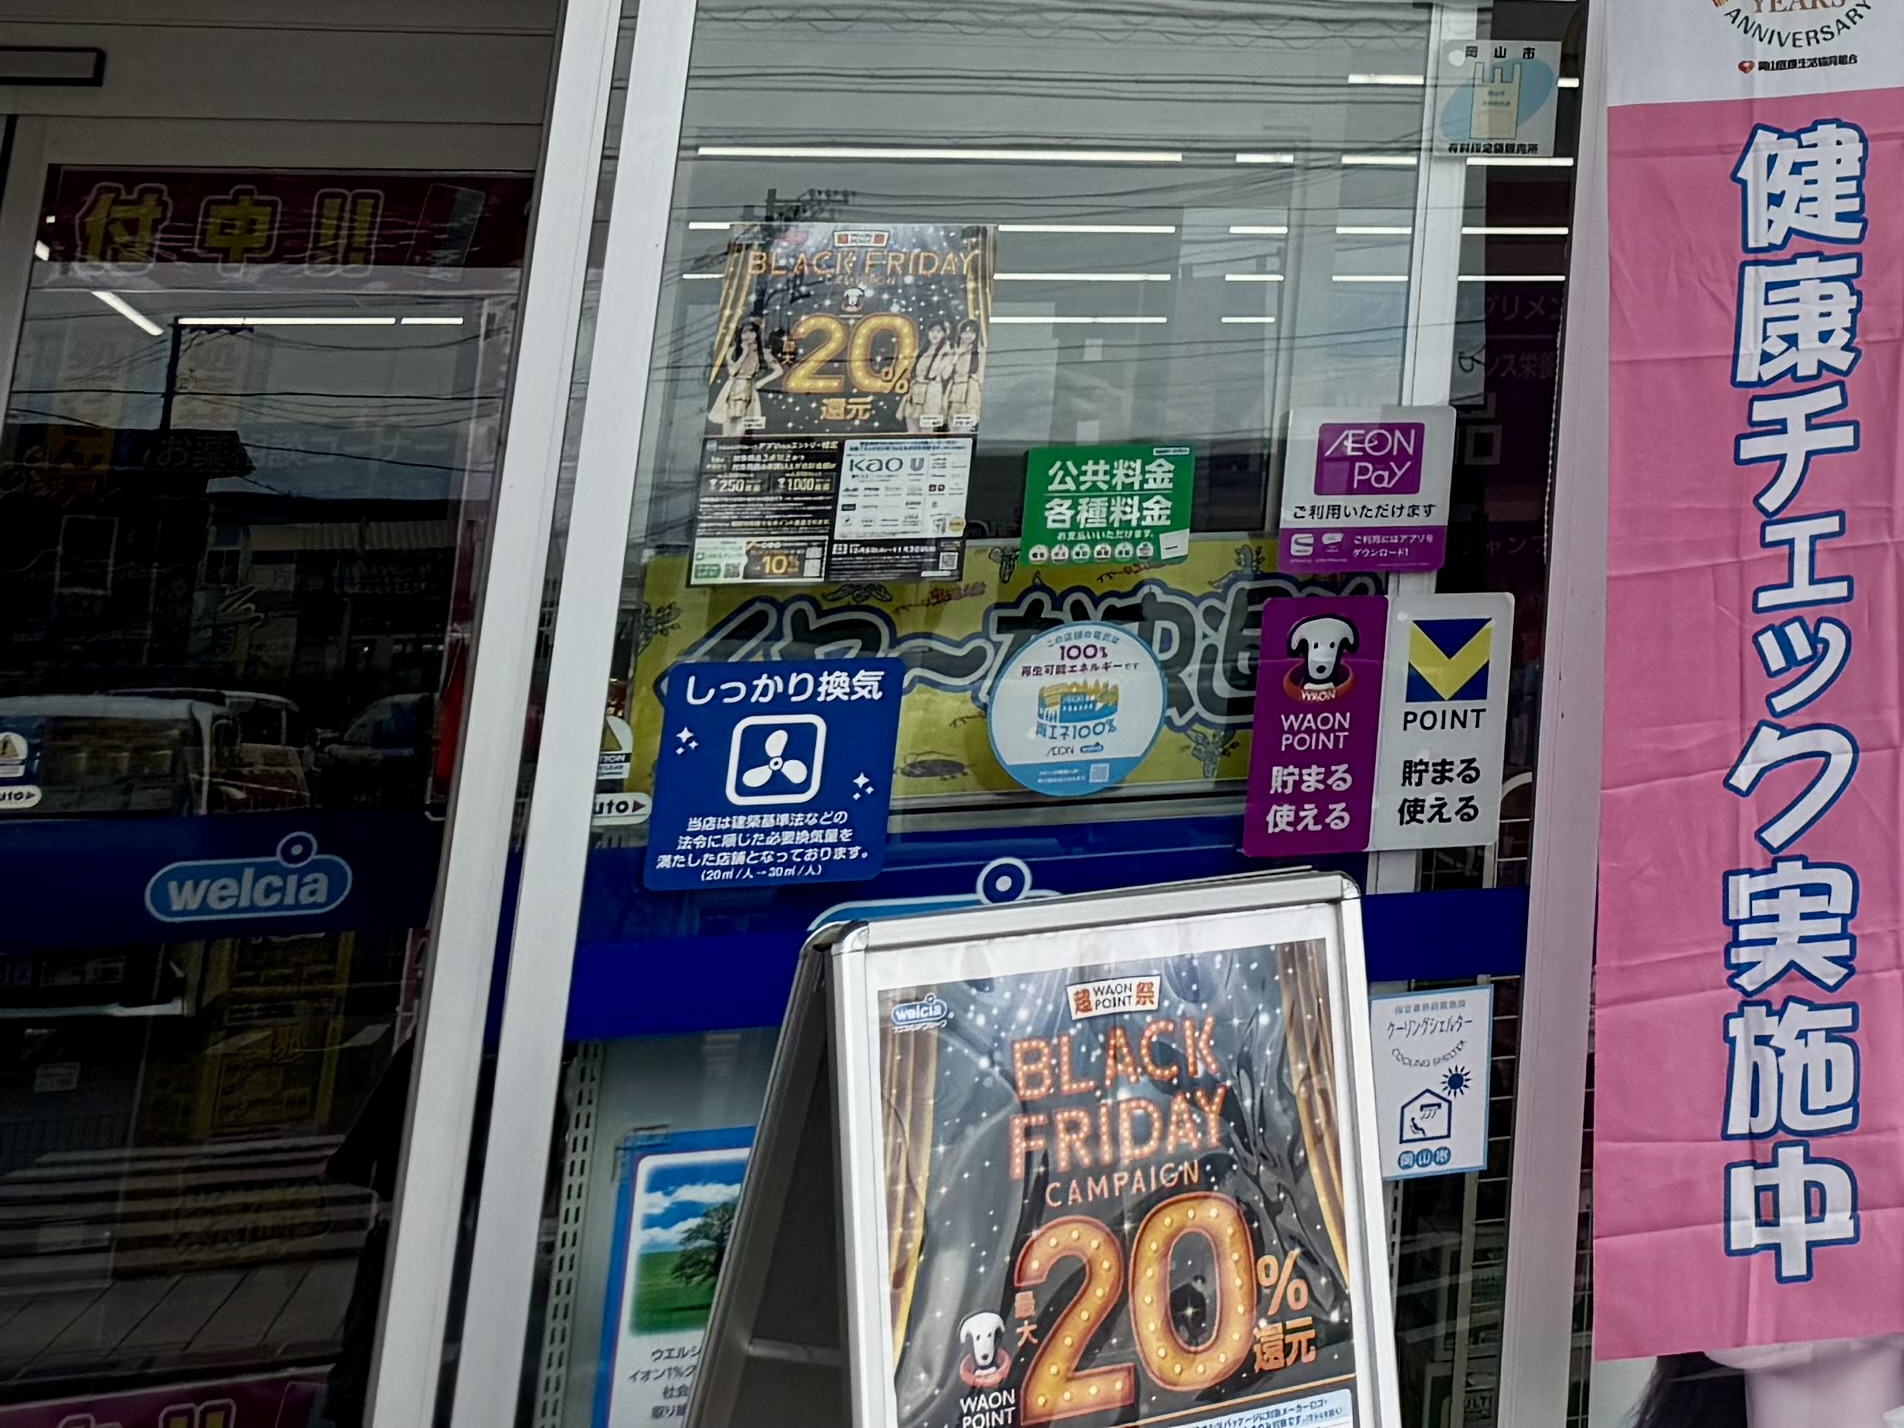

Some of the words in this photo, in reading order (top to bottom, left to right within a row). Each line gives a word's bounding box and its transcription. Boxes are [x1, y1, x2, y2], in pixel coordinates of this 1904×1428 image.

[747, 250, 858, 276] BLACK
[864, 250, 980, 276] FRIDAY
[783, 311, 919, 395] 20%
[820, 396, 873, 421] 還元
[1046, 458, 1175, 493] 公共料金
[1042, 494, 1172, 529] 各種料金
[1293, 503, 1436, 520] ご利用いただけます
[685, 669, 886, 706] しっかり換気
[1403, 708, 1487, 732] POINT
[1726, 127, 1865, 1283] 健康チェック実施中
[1281, 712, 1350, 732] WAON
[1281, 732, 1349, 752] POINT
[1269, 763, 1353, 794] 貯まる
[1401, 757, 1481, 787] 貯まる
[686, 810, 849, 832] 当店は建築基準法などの
[1265, 802, 1351, 834] 使える
[1397, 795, 1480, 826] 使える
[655, 845, 869, 870] 満たした店舗となっております。
[166, 865, 331, 913] welcia
[1092, 982, 1133, 997] WAON
[1094, 995, 1134, 1011] POINT
[1135, 982, 1156, 1007] 祭
[895, 1000, 945, 1023] welcia
[1009, 1015, 1219, 1102] BLACK
[1007, 1083, 1230, 1182] FRIDAY
[1044, 1159, 1200, 1208] CAMPAIGN
[1013, 1291, 1039, 1346] 最大
[1253, 1316, 1318, 1373] 還元
[959, 1387, 1017, 1412] WAON
[961, 1408, 1017, 1428] POINT
